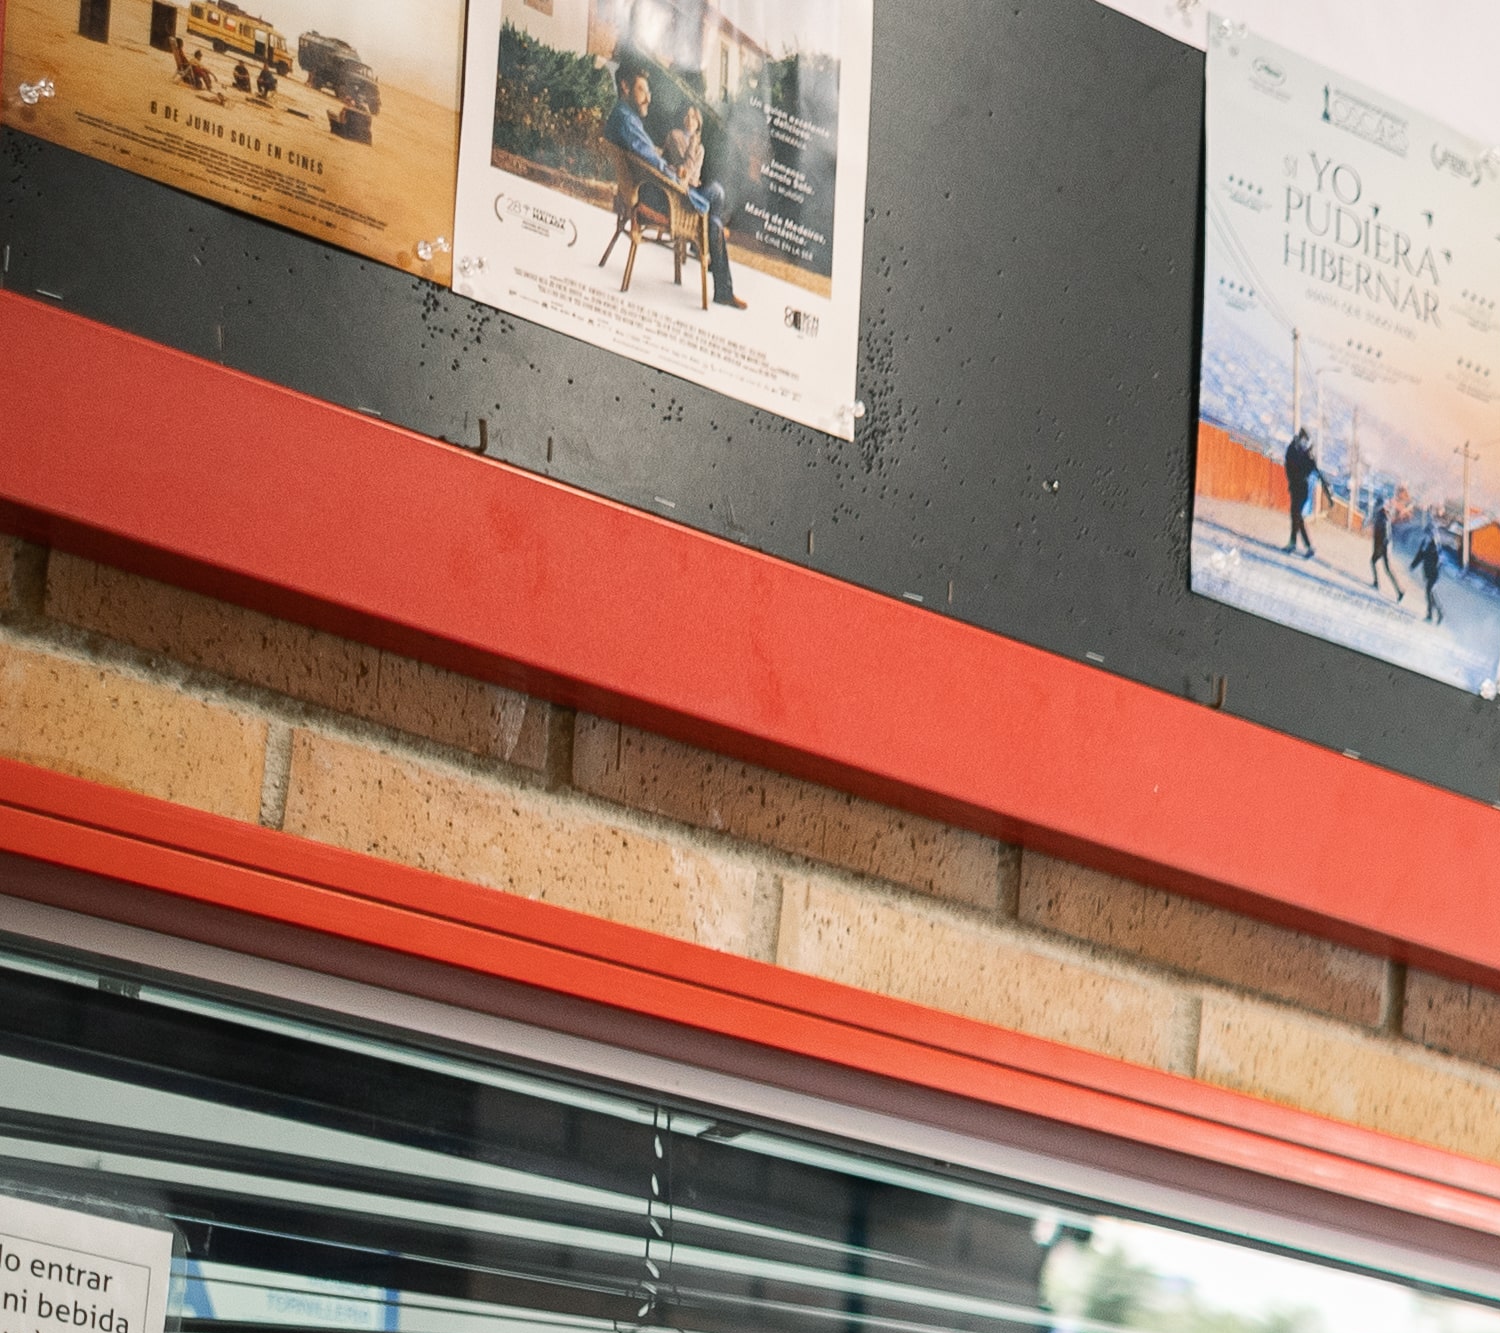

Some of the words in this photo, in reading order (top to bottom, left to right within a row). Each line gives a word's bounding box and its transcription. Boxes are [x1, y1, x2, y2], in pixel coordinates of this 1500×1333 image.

[165, 104, 179, 122] DE
[186, 111, 224, 138] JUNIO
[231, 130, 261, 152] SOLO
[268, 142, 282, 160] EN
[288, 150, 324, 176] CINES
[1310, 150, 1361, 205] YO
[1284, 185, 1440, 286] PUDIERA
[1283, 231, 1441, 329] HIBERNAR
[3, 1289, 27, 1313] ni
[30, 1258, 113, 1293] entrar
